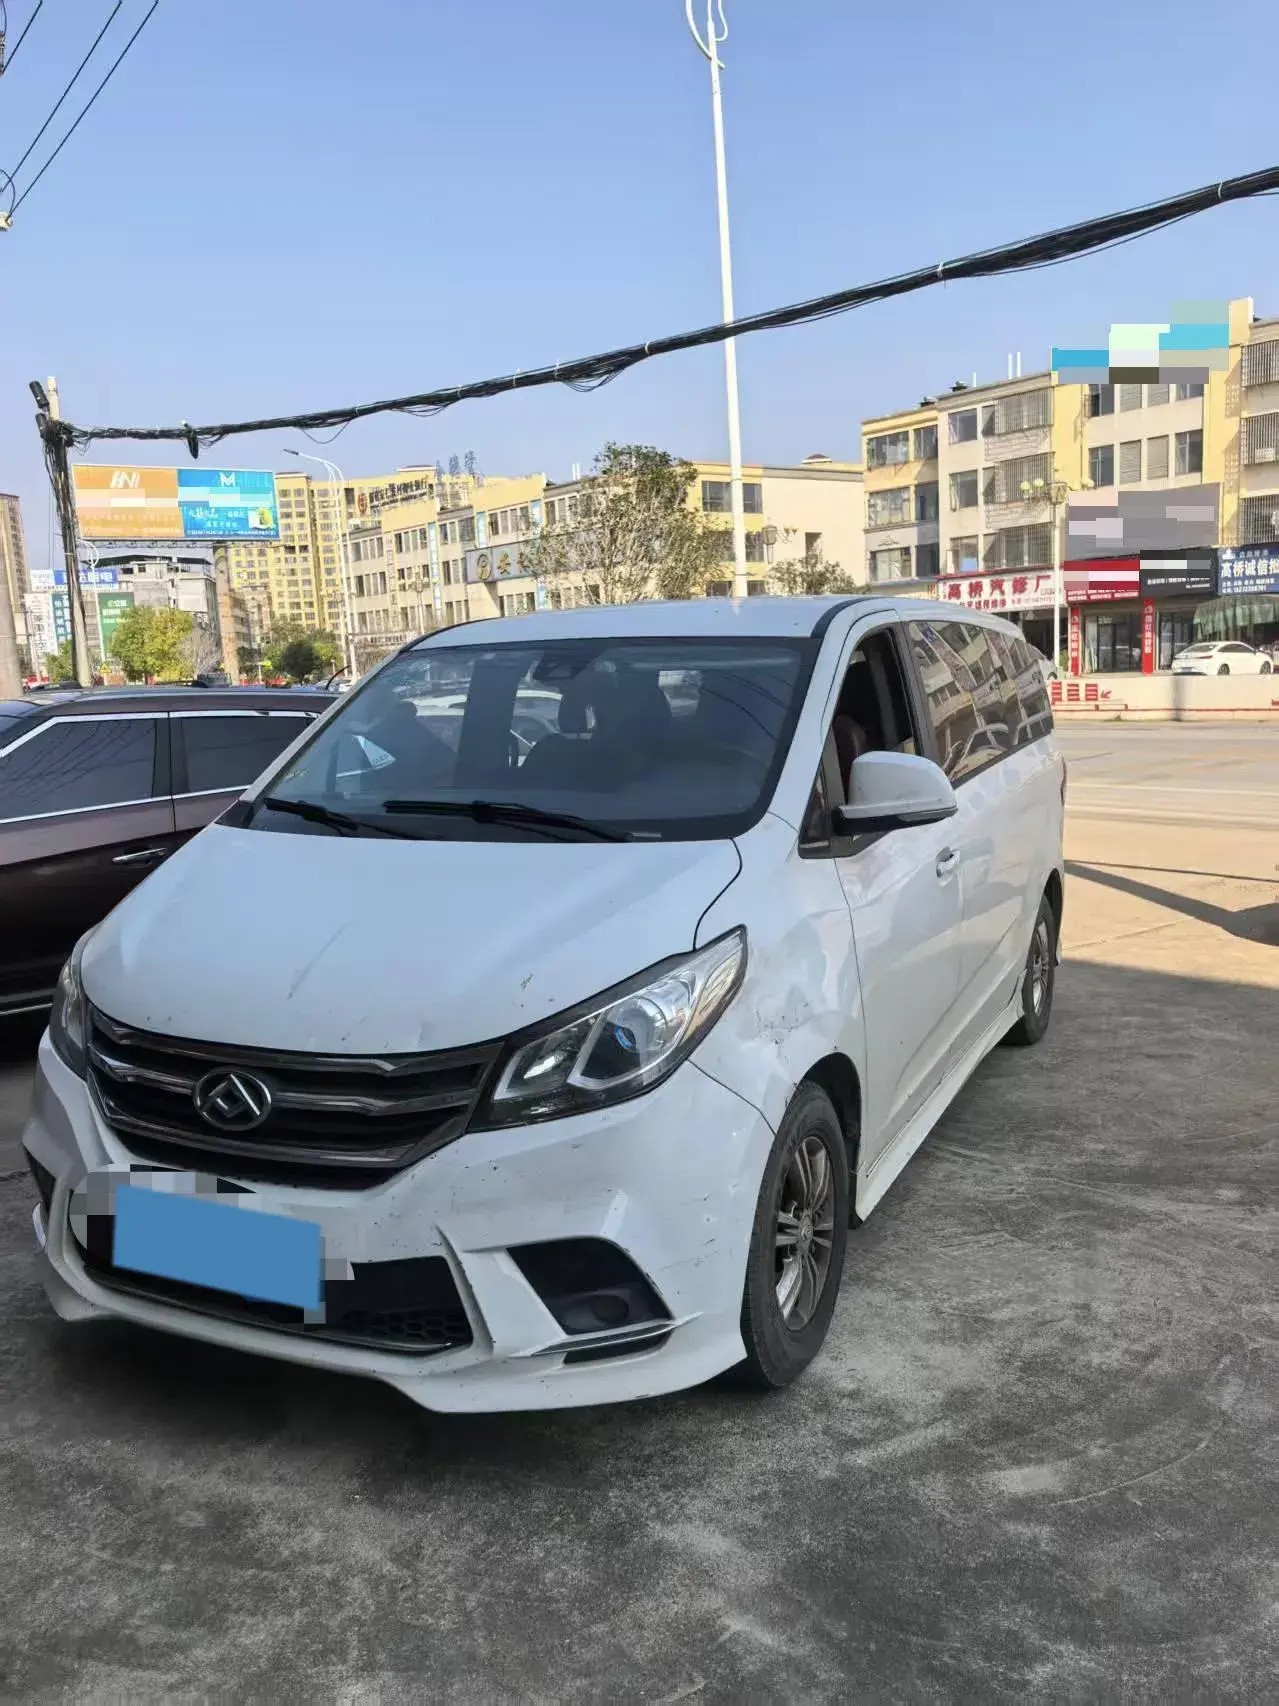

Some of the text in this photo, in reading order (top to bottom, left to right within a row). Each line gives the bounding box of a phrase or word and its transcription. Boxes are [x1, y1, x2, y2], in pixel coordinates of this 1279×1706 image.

[948, 574, 1052, 600] 高桥汽修厂
